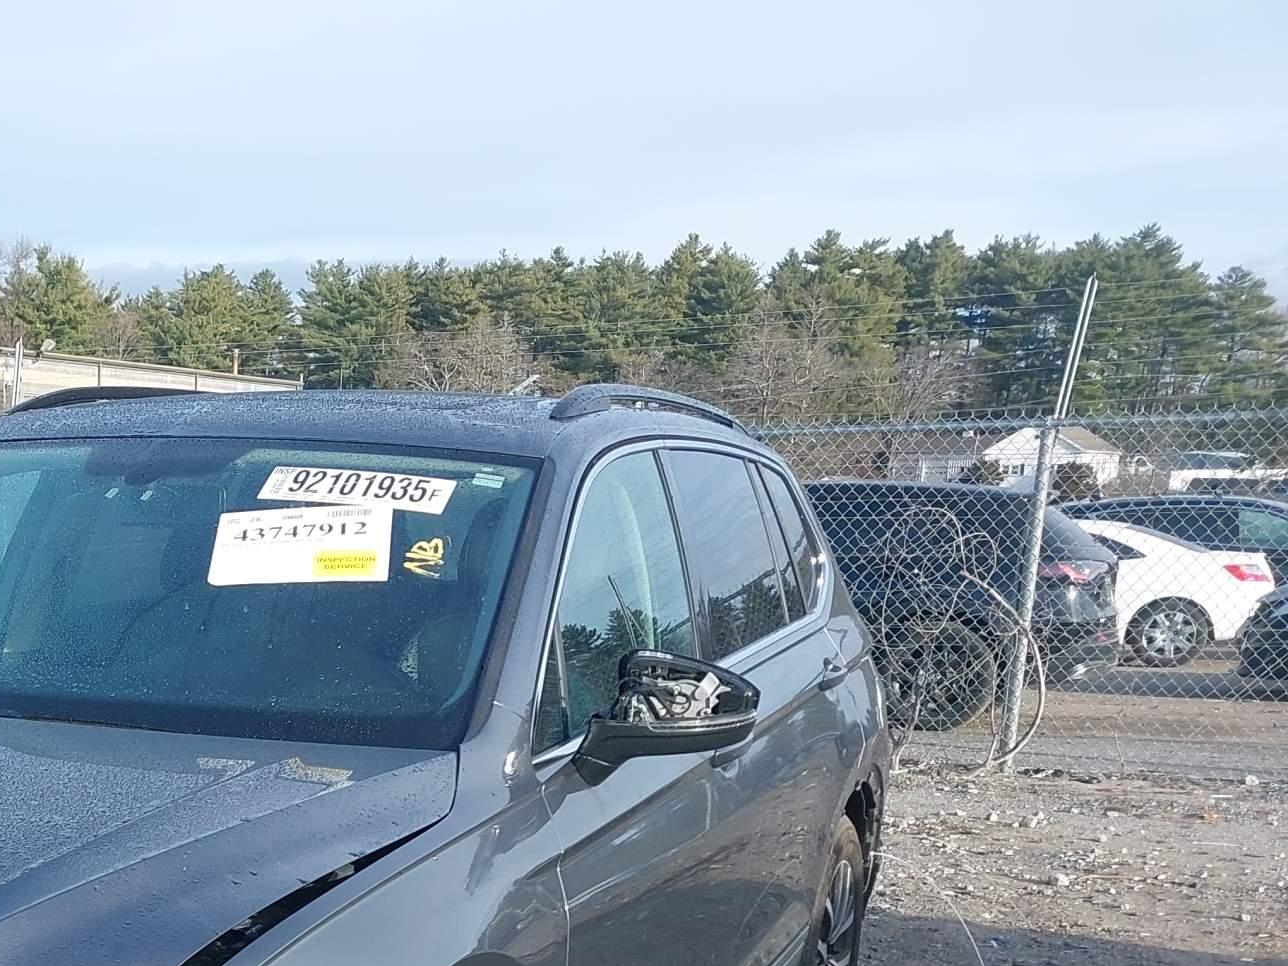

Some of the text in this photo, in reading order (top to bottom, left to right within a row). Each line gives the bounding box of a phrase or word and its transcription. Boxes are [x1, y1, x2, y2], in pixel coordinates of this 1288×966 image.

[288, 469, 432, 503] 92101935
[428, 488, 443, 502] F
[233, 521, 368, 542] 43747912
